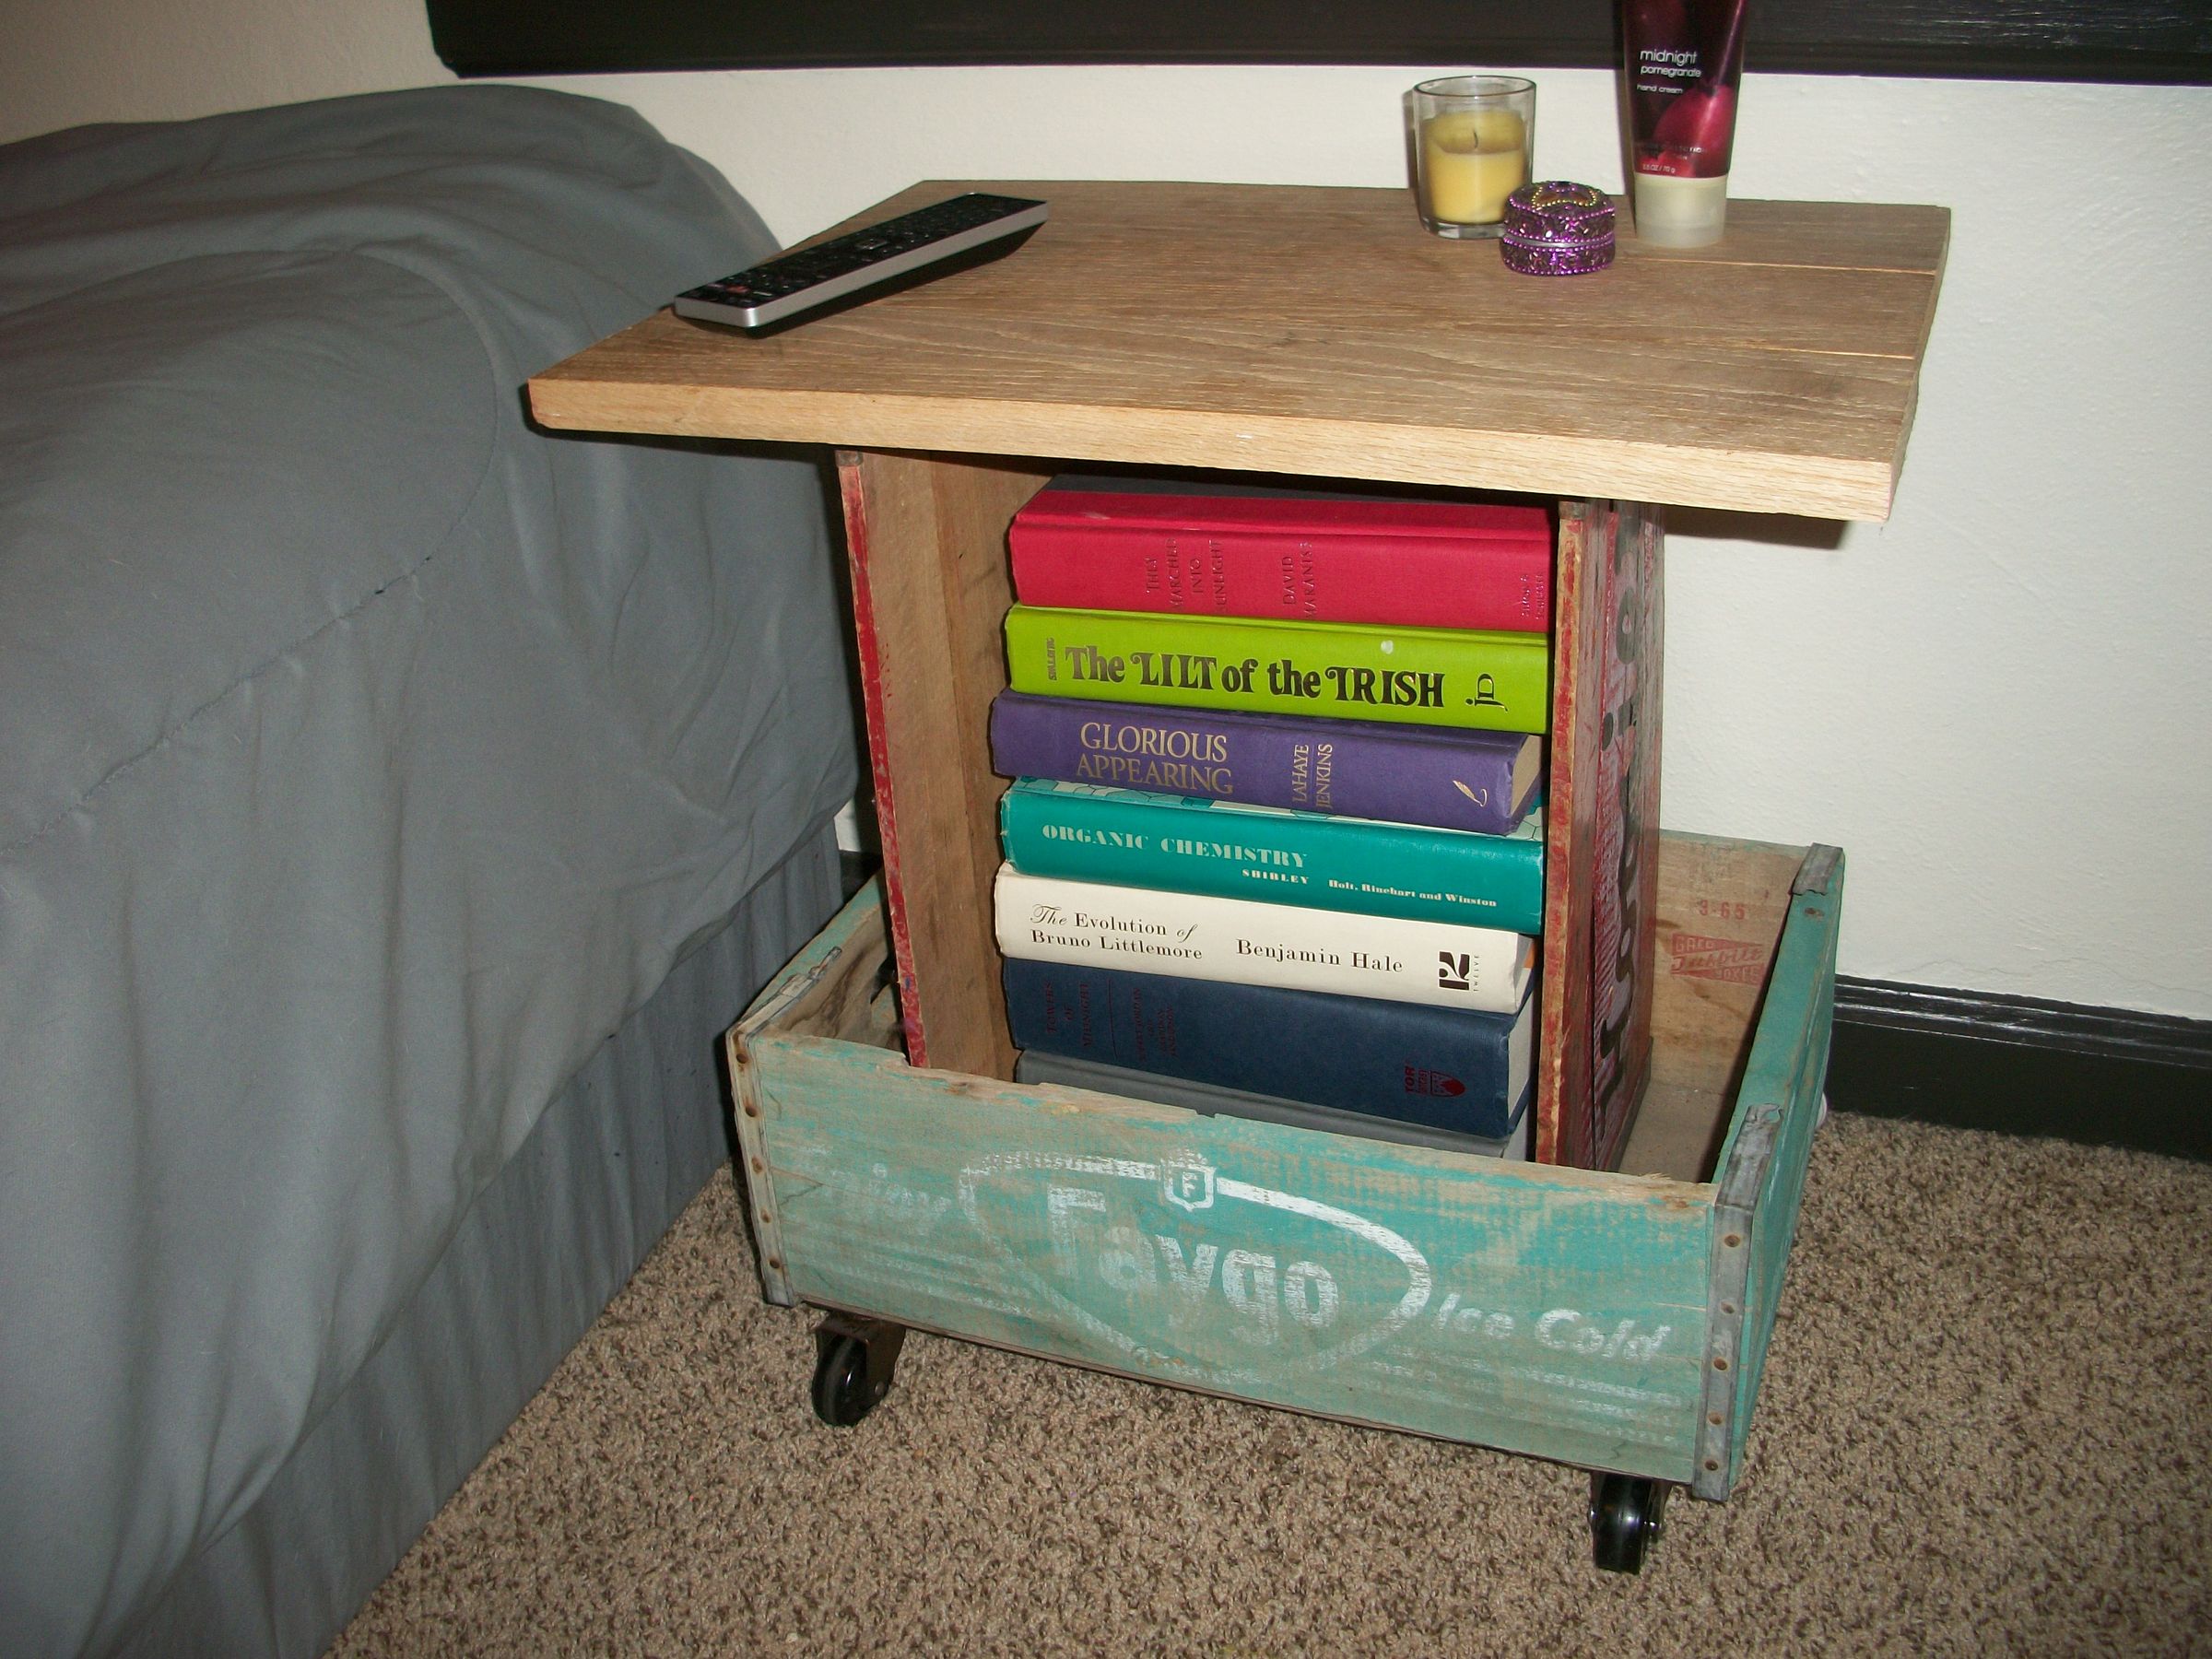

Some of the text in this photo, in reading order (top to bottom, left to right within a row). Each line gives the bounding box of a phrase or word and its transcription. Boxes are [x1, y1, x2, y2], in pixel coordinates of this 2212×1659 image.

[1640, 49, 1698, 66] midnight
[1641, 65, 1701, 78] pomegranate
[1637, 84, 1657, 92] hand
[1146, 558, 1159, 594] THEY
[1190, 558, 1204, 594] INTO
[1281, 556, 1296, 606] DAVID
[1065, 645, 1445, 708] The LILT of the IRISH
[1080, 722, 1227, 762] GLORIOUS
[1077, 753, 1233, 794] APPEARING
[1292, 744, 1309, 803] LAHAYE
[1316, 744, 1333, 808] JENKINS
[1042, 824, 1307, 868] ORGANIC CHEMISTRY
[1242, 868, 1310, 885] SHIRLEY
[1361, 884, 1416, 899] Rinehart
[1419, 891, 1441, 900] and
[1445, 894, 1497, 907] Winston
[1030, 904, 1198, 943] The Evolution of
[1030, 929, 1203, 959] Bruno Littlemore
[1236, 939, 1403, 972] Benjamin Hale
[1047, 1183, 1339, 1347] Faygo
[1431, 1292, 1672, 1361] Ice Cold
